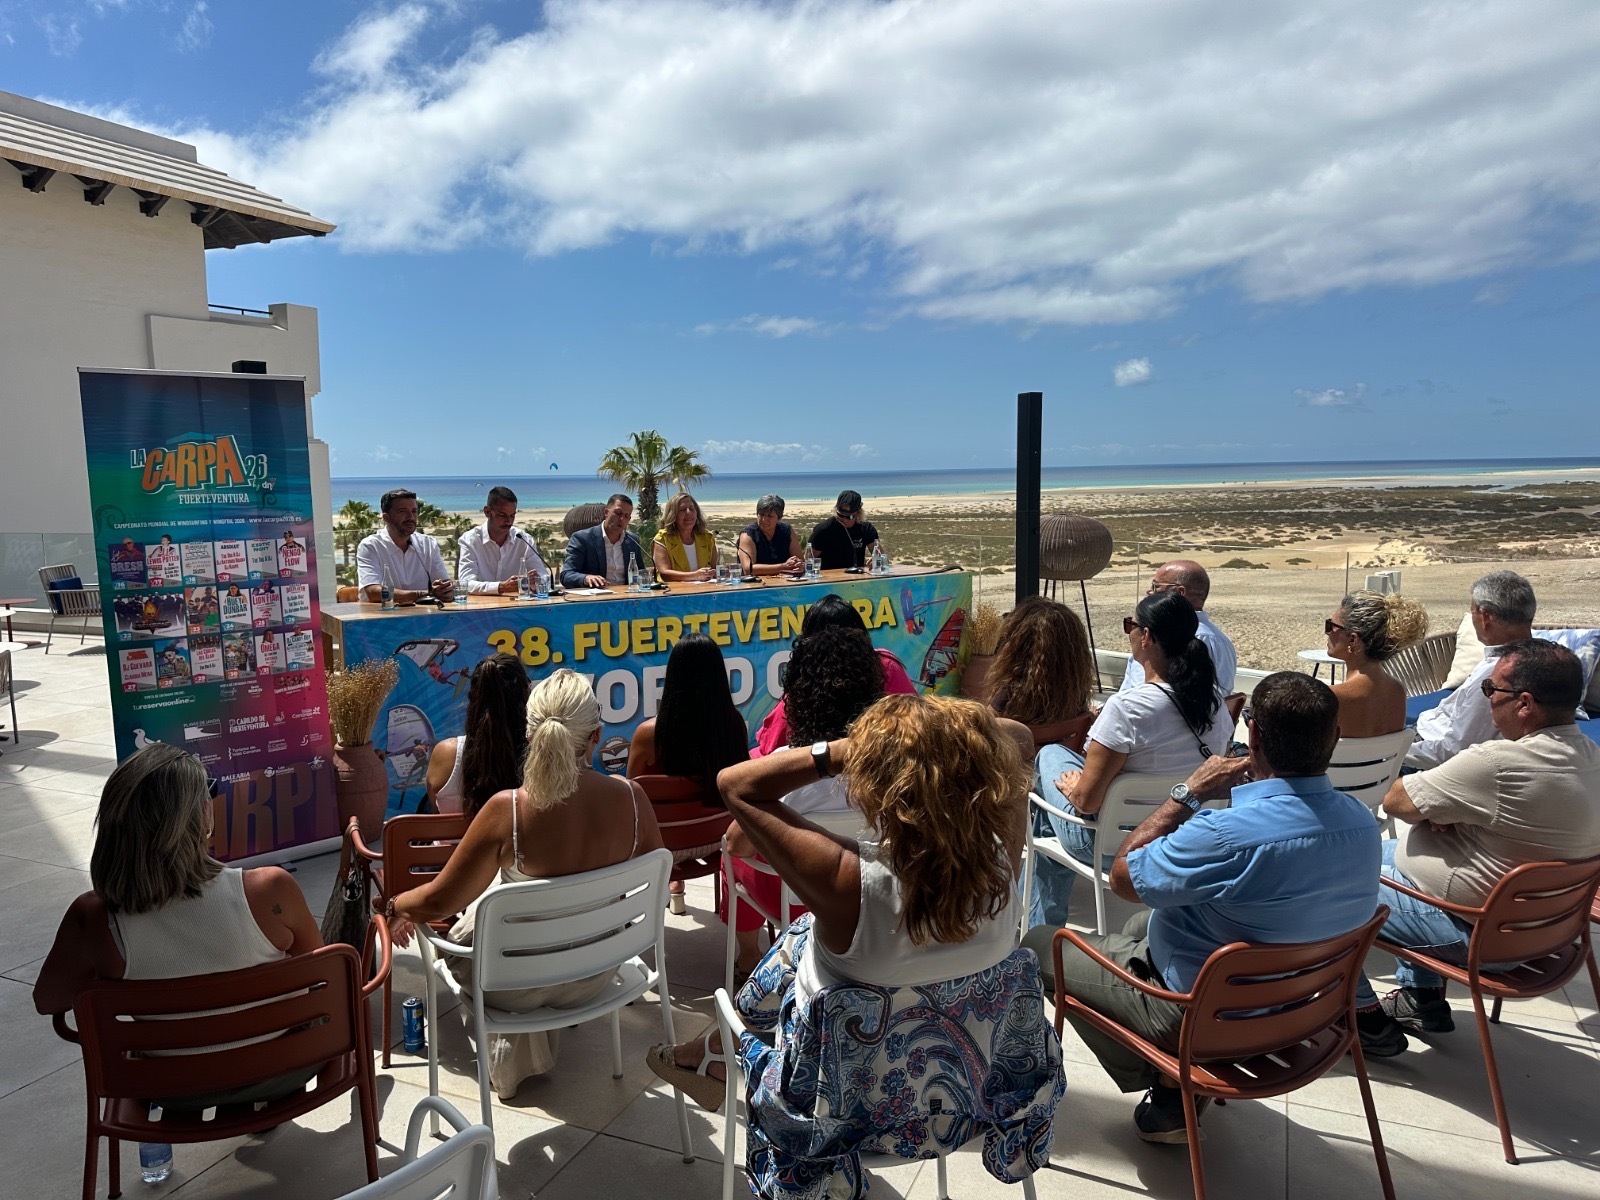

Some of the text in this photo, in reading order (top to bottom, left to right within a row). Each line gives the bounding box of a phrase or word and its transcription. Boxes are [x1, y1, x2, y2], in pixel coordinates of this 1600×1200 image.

[130, 435, 268, 492] LA CARPA 26
[179, 493, 250, 505] FUERTEVENTURA
[249, 516, 302, 524] www.lacarpa2026.es
[283, 546, 301, 557] NENGO
[111, 561, 144, 573] BRESH
[285, 558, 300, 566] FLOW
[253, 595, 266, 605] LION
[223, 604, 247, 615] DUNBAR
[487, 596, 897, 666] 38. FUERTEVENRA
[261, 643, 280, 653] OMEGA
[130, 661, 152, 670] GUEVARA
[237, 716, 258, 725] CABILDO
[229, 721, 269, 733] FUERTEVENTURA
